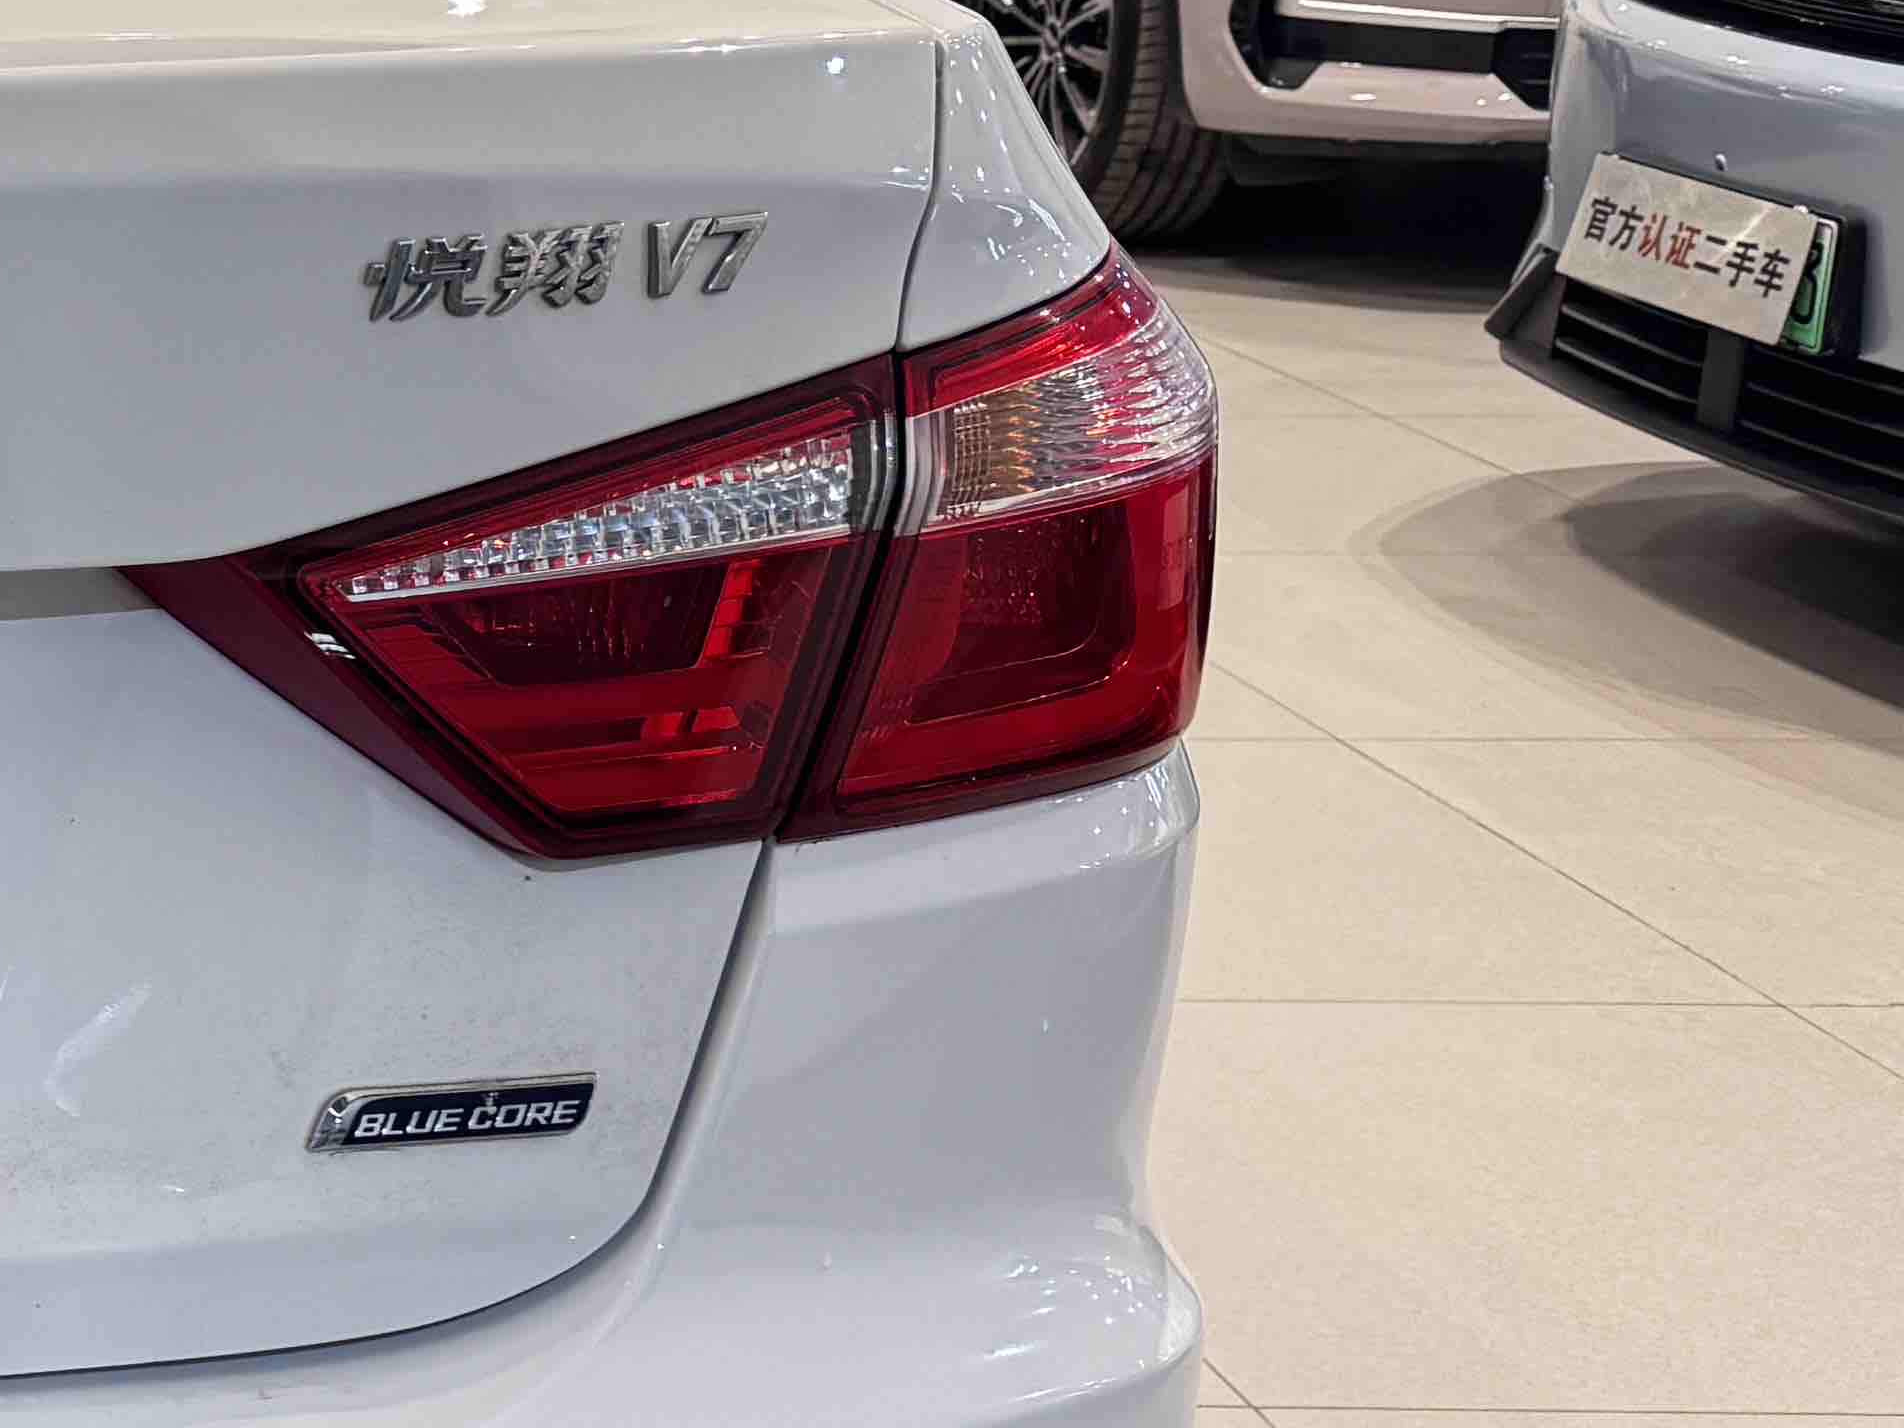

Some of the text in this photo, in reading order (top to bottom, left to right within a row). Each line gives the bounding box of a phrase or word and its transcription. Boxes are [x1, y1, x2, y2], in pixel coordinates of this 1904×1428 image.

[364, 211, 768, 321] 悦翔 V7
[1583, 195, 1792, 299] 官方认证二手车
[354, 1099, 581, 1137] BLUE CORE
